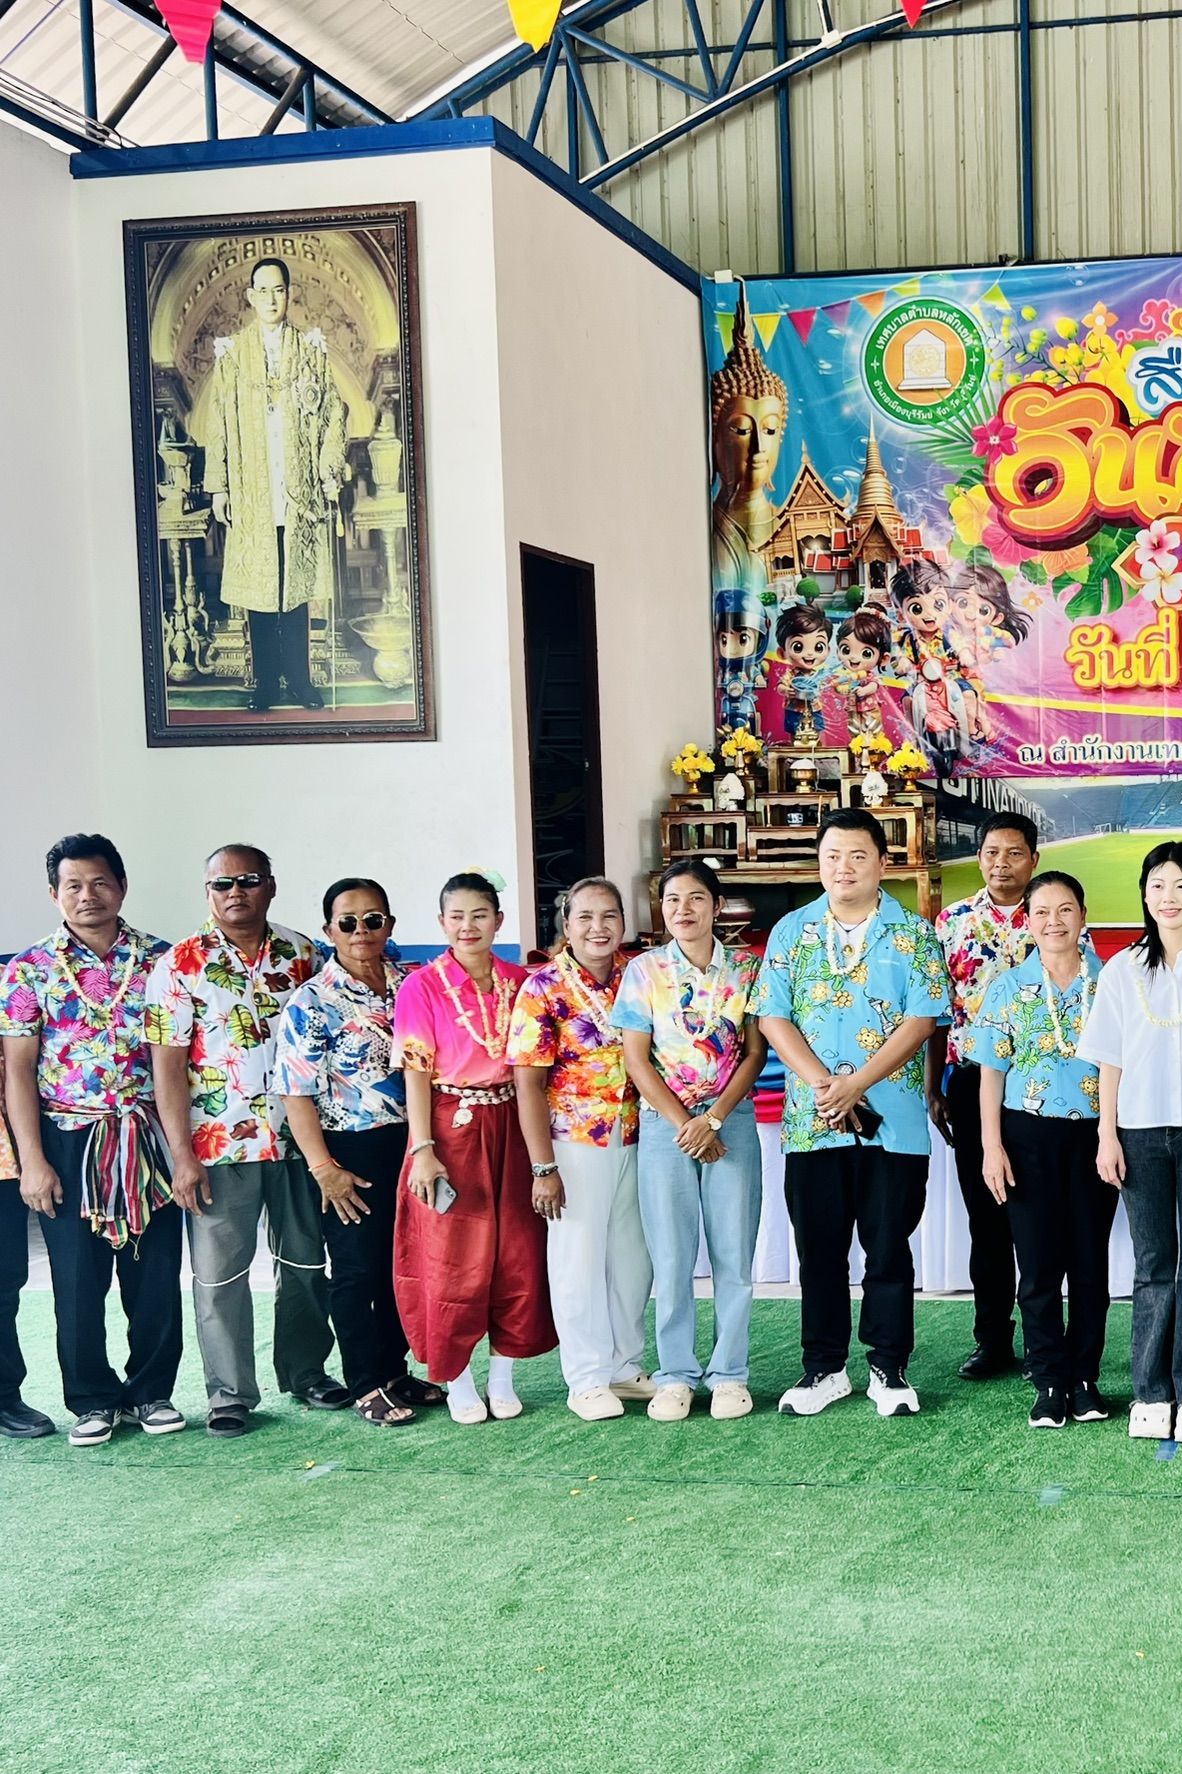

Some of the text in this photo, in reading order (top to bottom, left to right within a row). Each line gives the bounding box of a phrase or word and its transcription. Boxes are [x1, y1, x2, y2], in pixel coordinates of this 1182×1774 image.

[1068, 609, 1176, 683] วันที่
[1019, 744, 1043, 764] ณ
